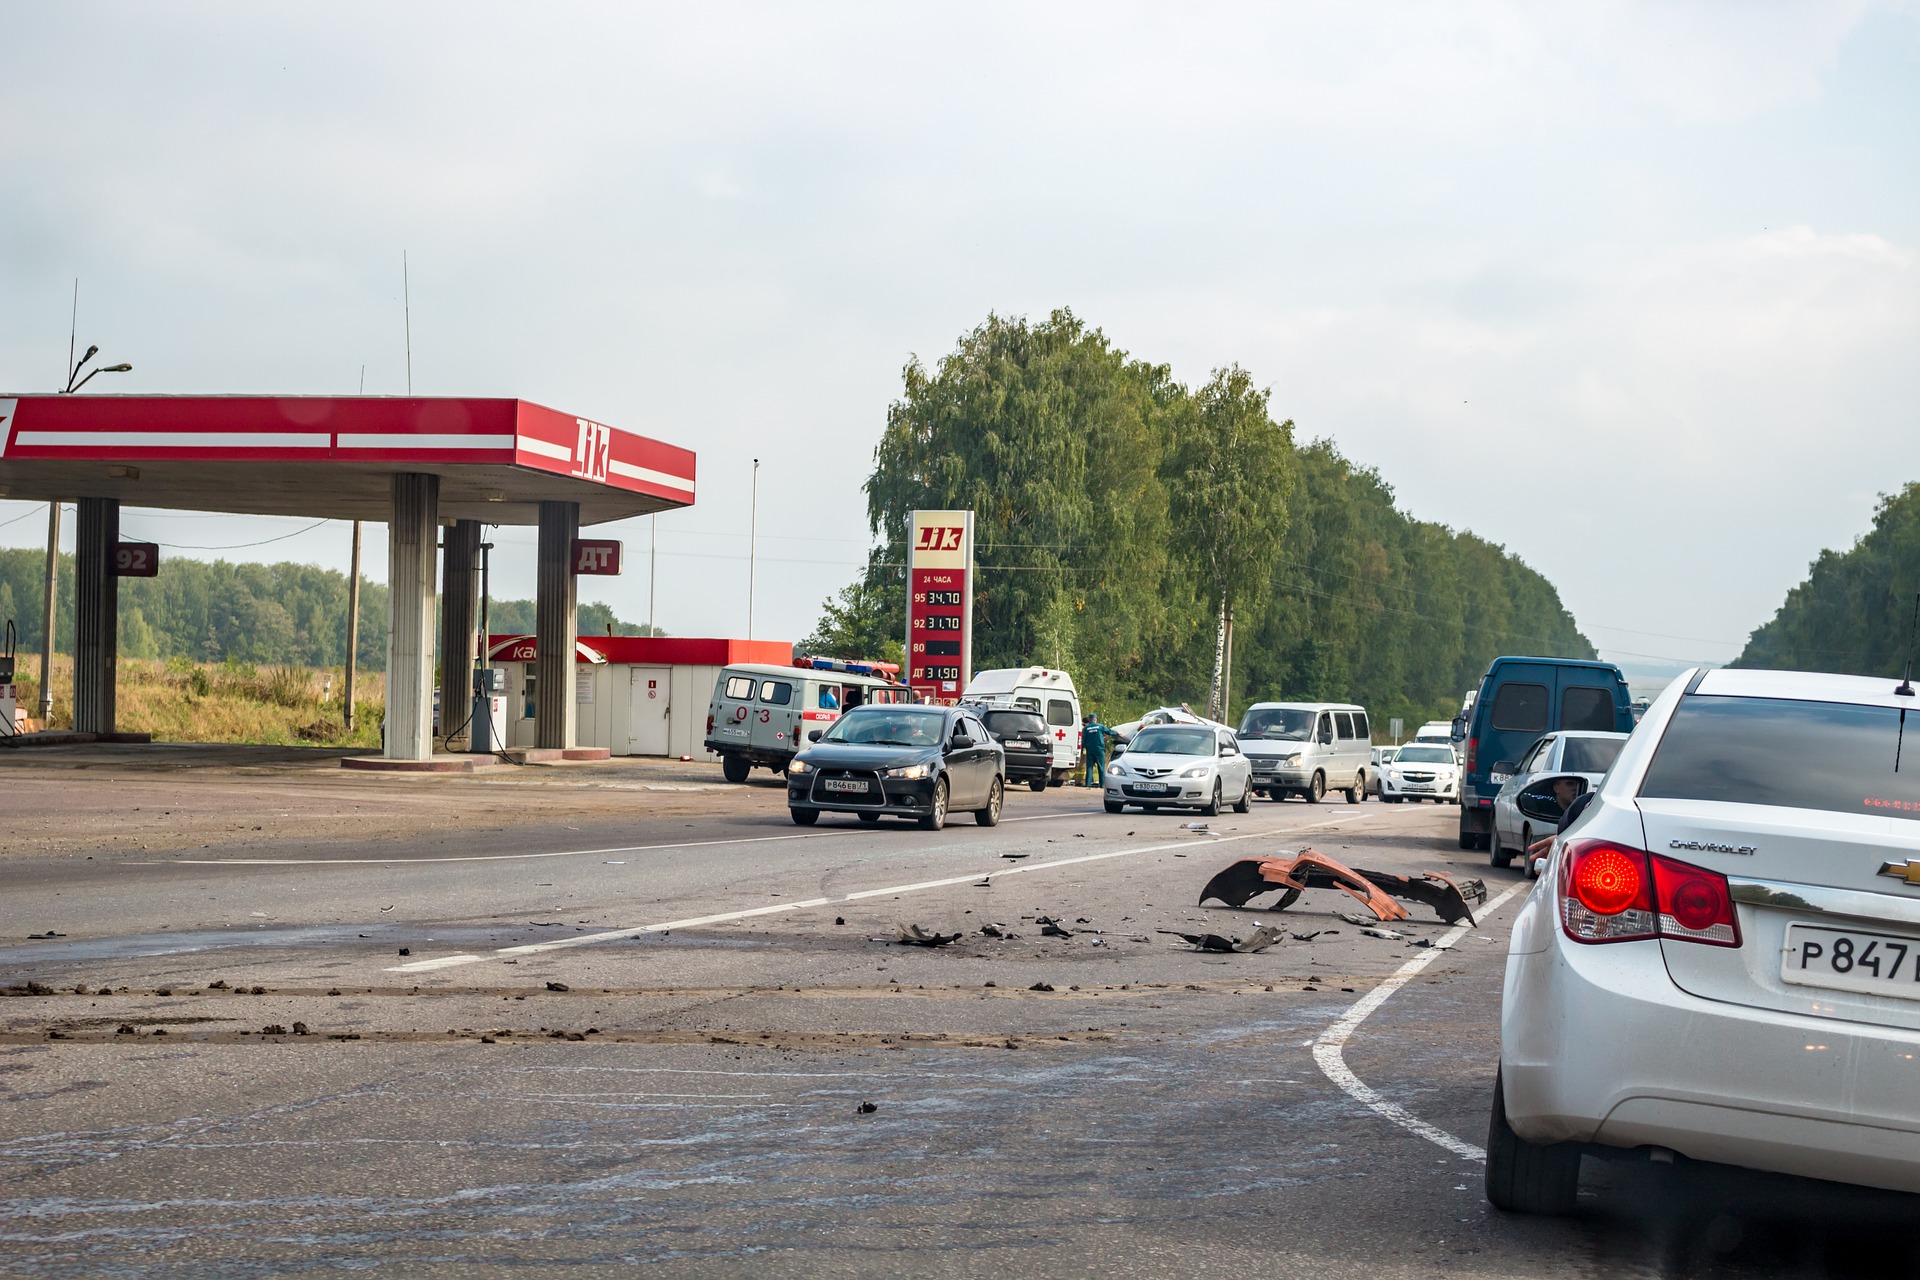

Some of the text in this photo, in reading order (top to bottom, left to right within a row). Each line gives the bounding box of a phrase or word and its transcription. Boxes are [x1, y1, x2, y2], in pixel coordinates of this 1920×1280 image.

[116, 549, 147, 569] 92
[578, 547, 612, 571] ДТ
[923, 575, 952, 584] 24 ЧАСА
[914, 592, 960, 604] 95 34.70
[913, 617, 959, 629] 92 31.70
[912, 643, 925, 653] 80
[912, 667, 958, 679] ДТ 31.90
[1669, 839, 1758, 856] CHEVROLET
